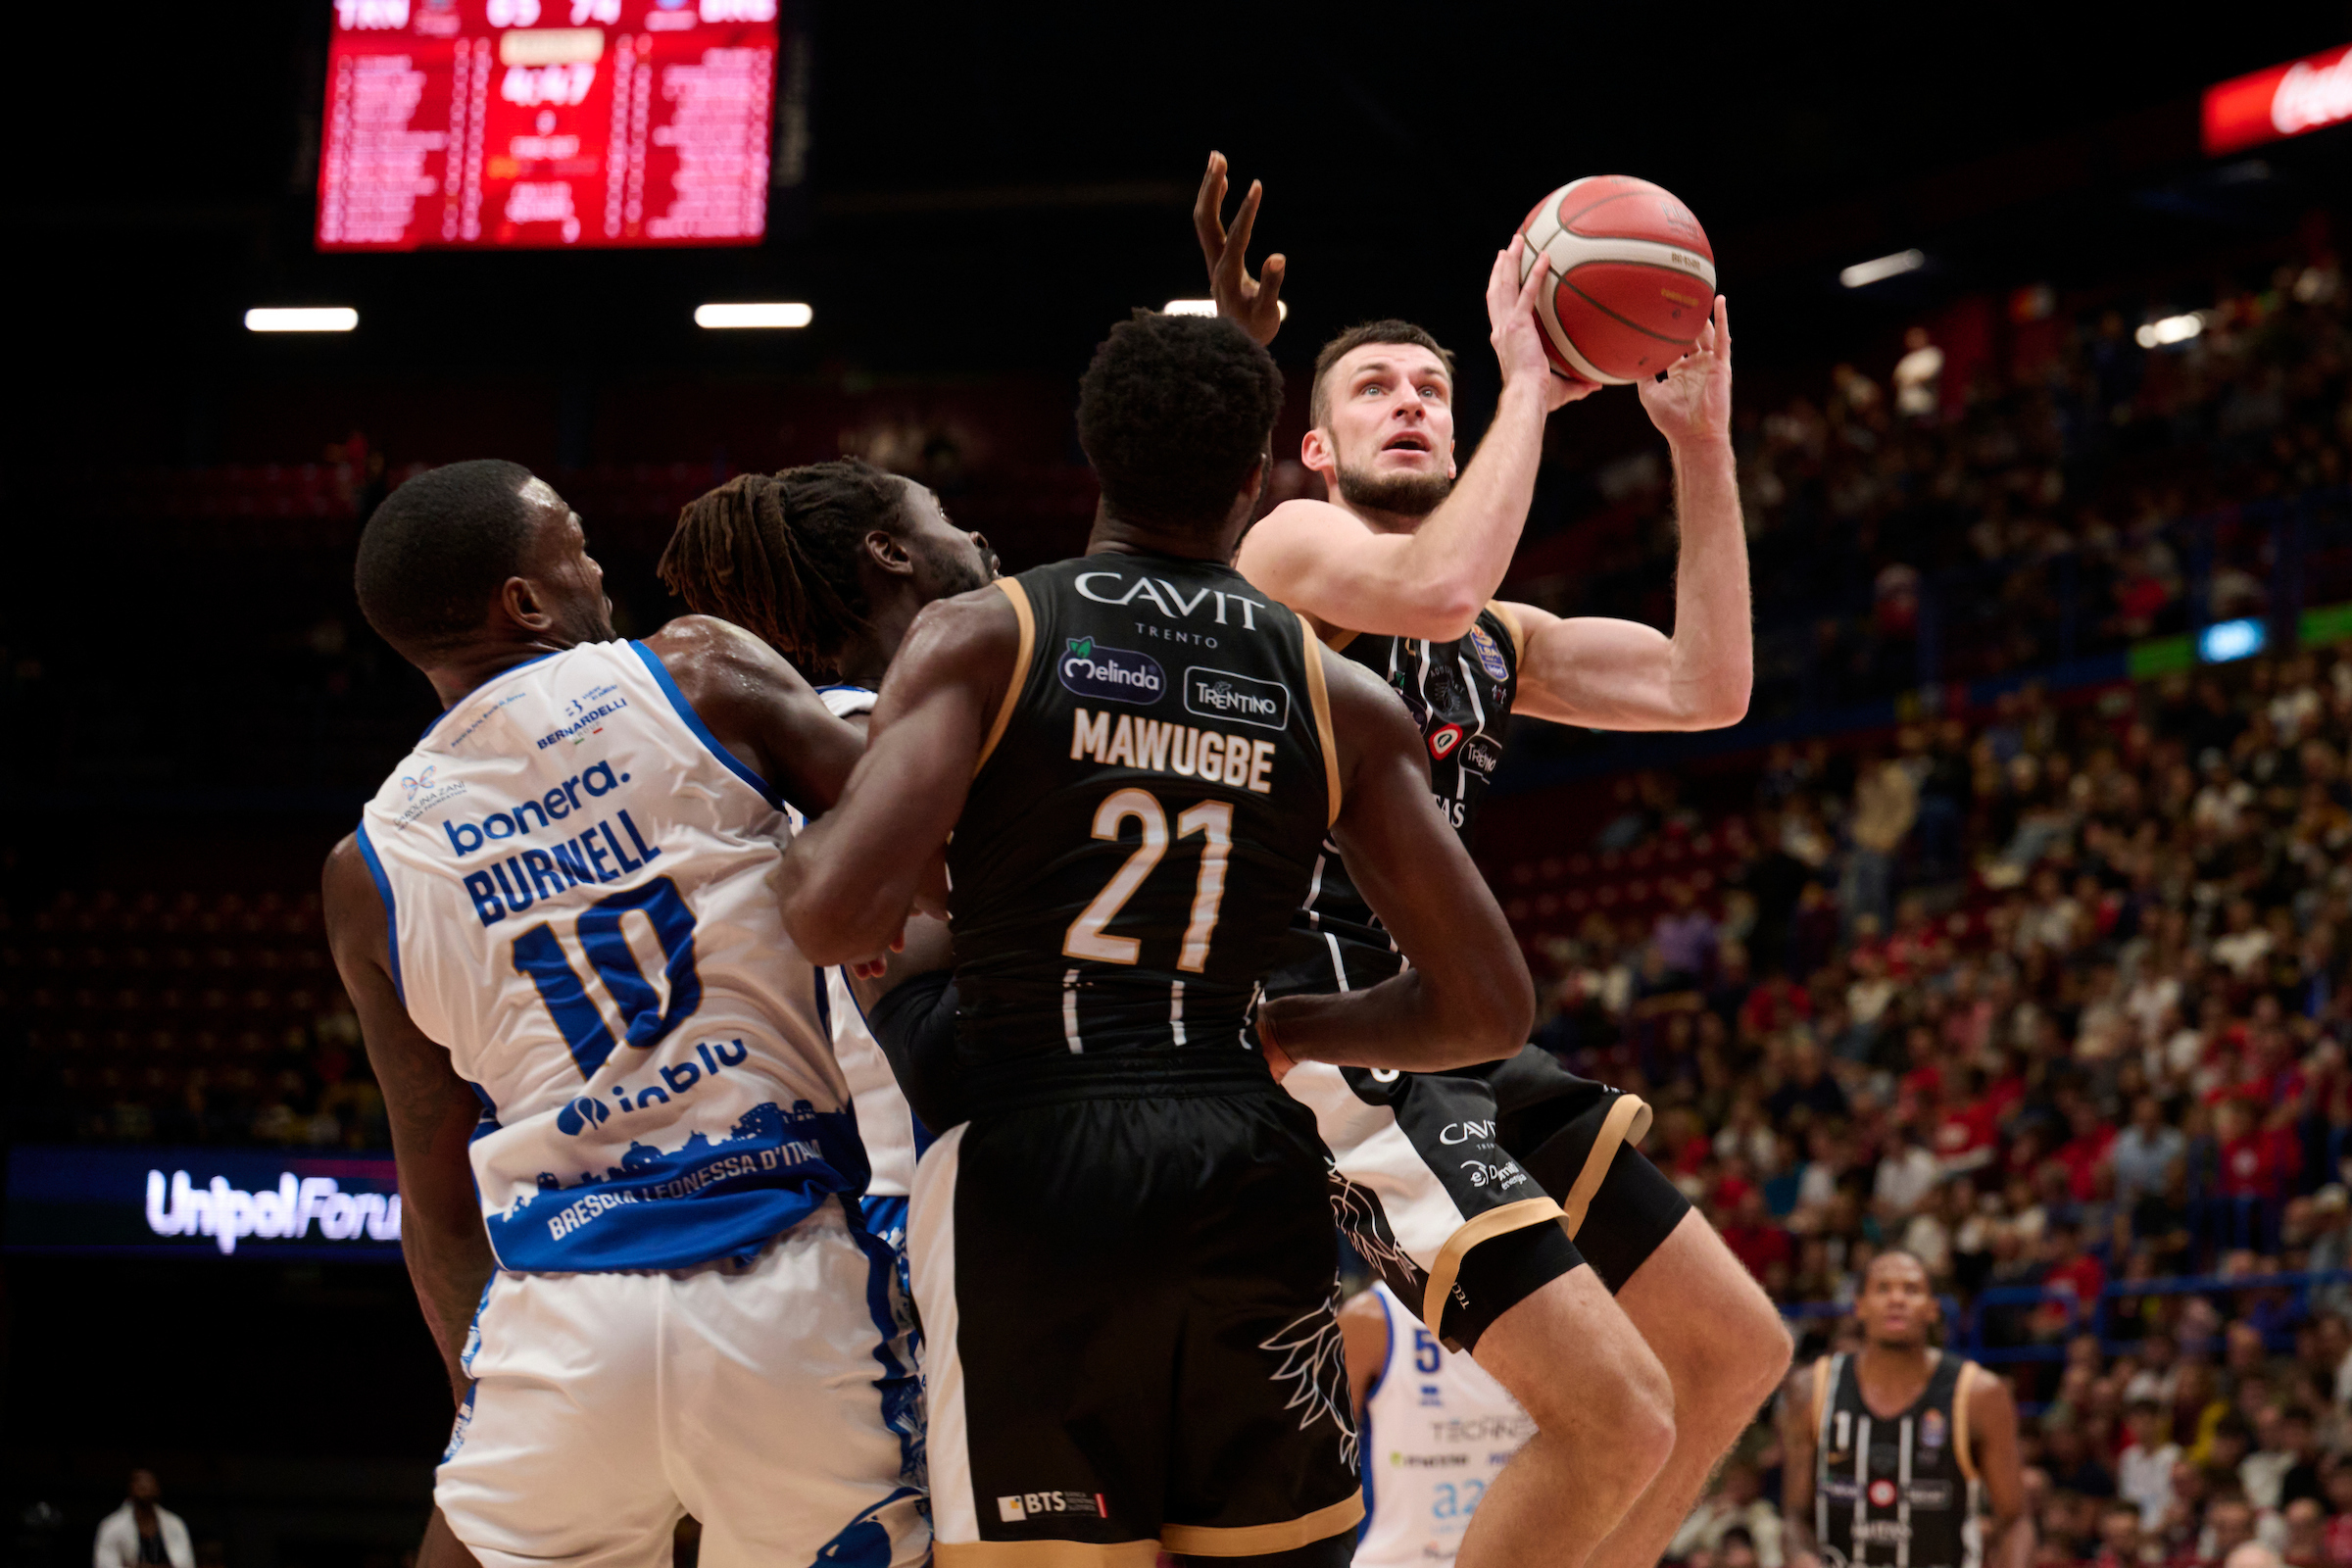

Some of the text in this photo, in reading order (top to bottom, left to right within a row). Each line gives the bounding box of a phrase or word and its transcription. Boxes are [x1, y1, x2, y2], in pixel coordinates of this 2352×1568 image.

[1075, 571, 1265, 630] CAVIT
[1135, 622, 1219, 649] TRENTO
[1064, 658, 1159, 691] Melinda
[1196, 682, 1277, 714] TRENTINO
[536, 697, 627, 750] BERNARDELLI
[1069, 708, 1275, 794] MAWUGBE
[443, 760, 631, 857] bonera.
[463, 808, 662, 928] BURNELL
[1062, 787, 1234, 973] 21
[511, 873, 704, 1083] 10
[643, 1156, 759, 1203] LEONESSA
[146, 1169, 402, 1255] UnipolForu
[1451, 1282, 1470, 1310] TEC
[1413, 1328, 1442, 1374] 5
[1024, 1491, 1067, 1514] BTS
